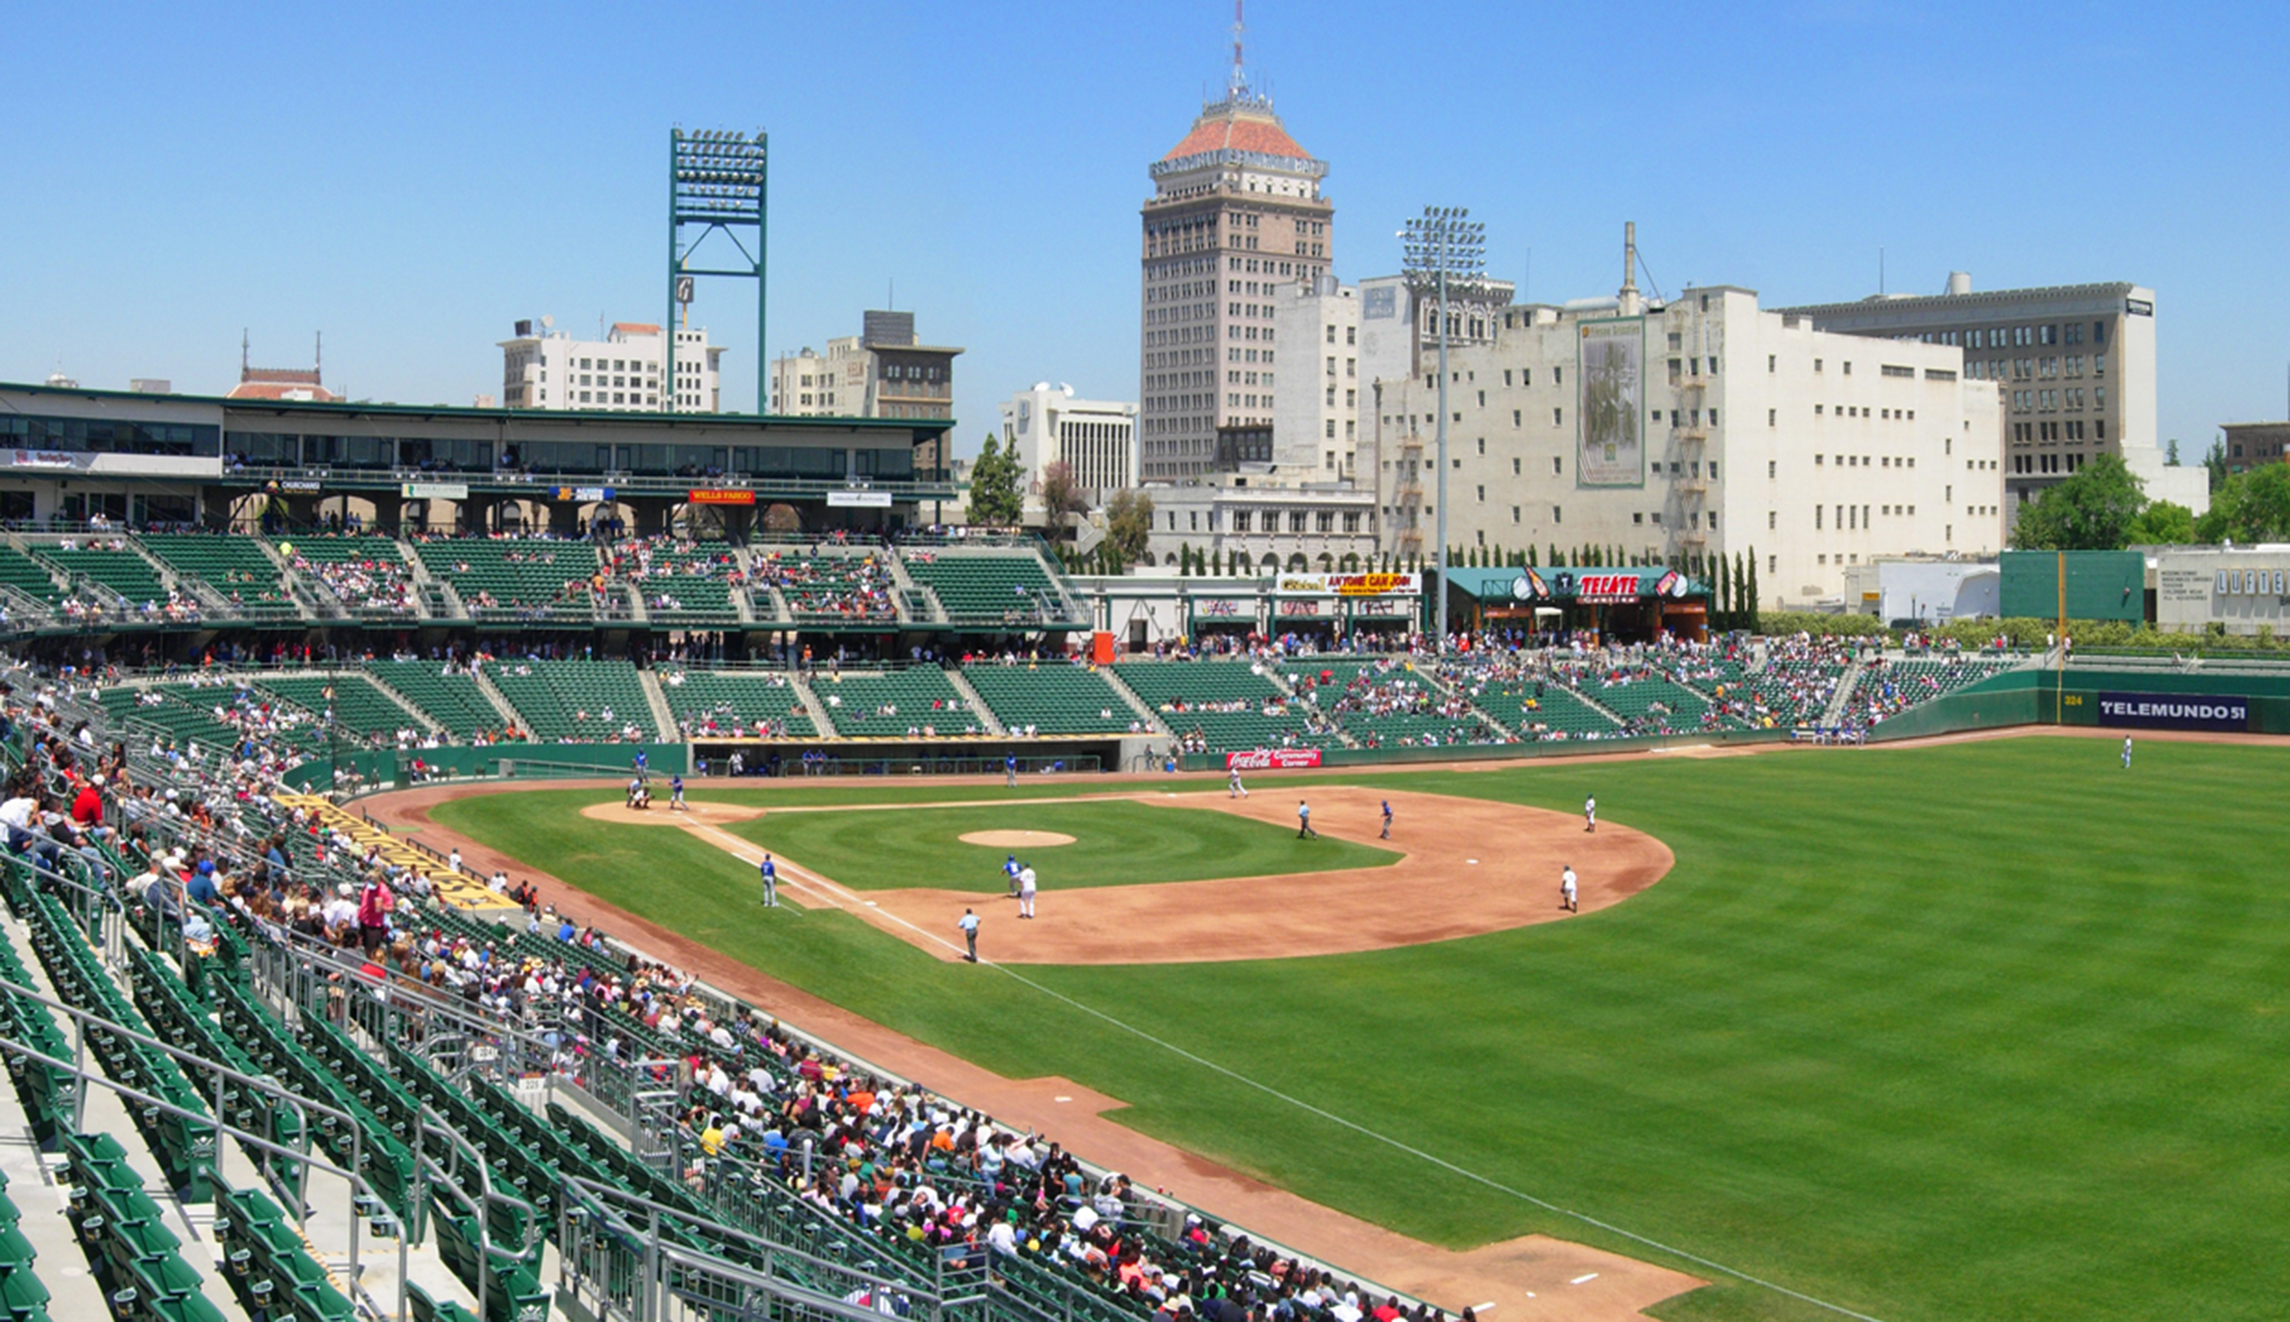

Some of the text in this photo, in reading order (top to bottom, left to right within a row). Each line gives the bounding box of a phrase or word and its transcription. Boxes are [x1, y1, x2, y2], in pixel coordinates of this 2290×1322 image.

[694, 491, 751, 500] WELLS FARGO
[1328, 575, 1366, 587] ANYONE
[1368, 575, 1388, 587] CAN
[1579, 574, 1640, 594] TECATE
[2064, 696, 2083, 706] 324
[2101, 701, 2246, 720] TELEMUNDO 51
[1230, 752, 1270, 769] Coca-Cola
[1273, 750, 1318, 760] Community
[1281, 759, 1309, 767] Corner
